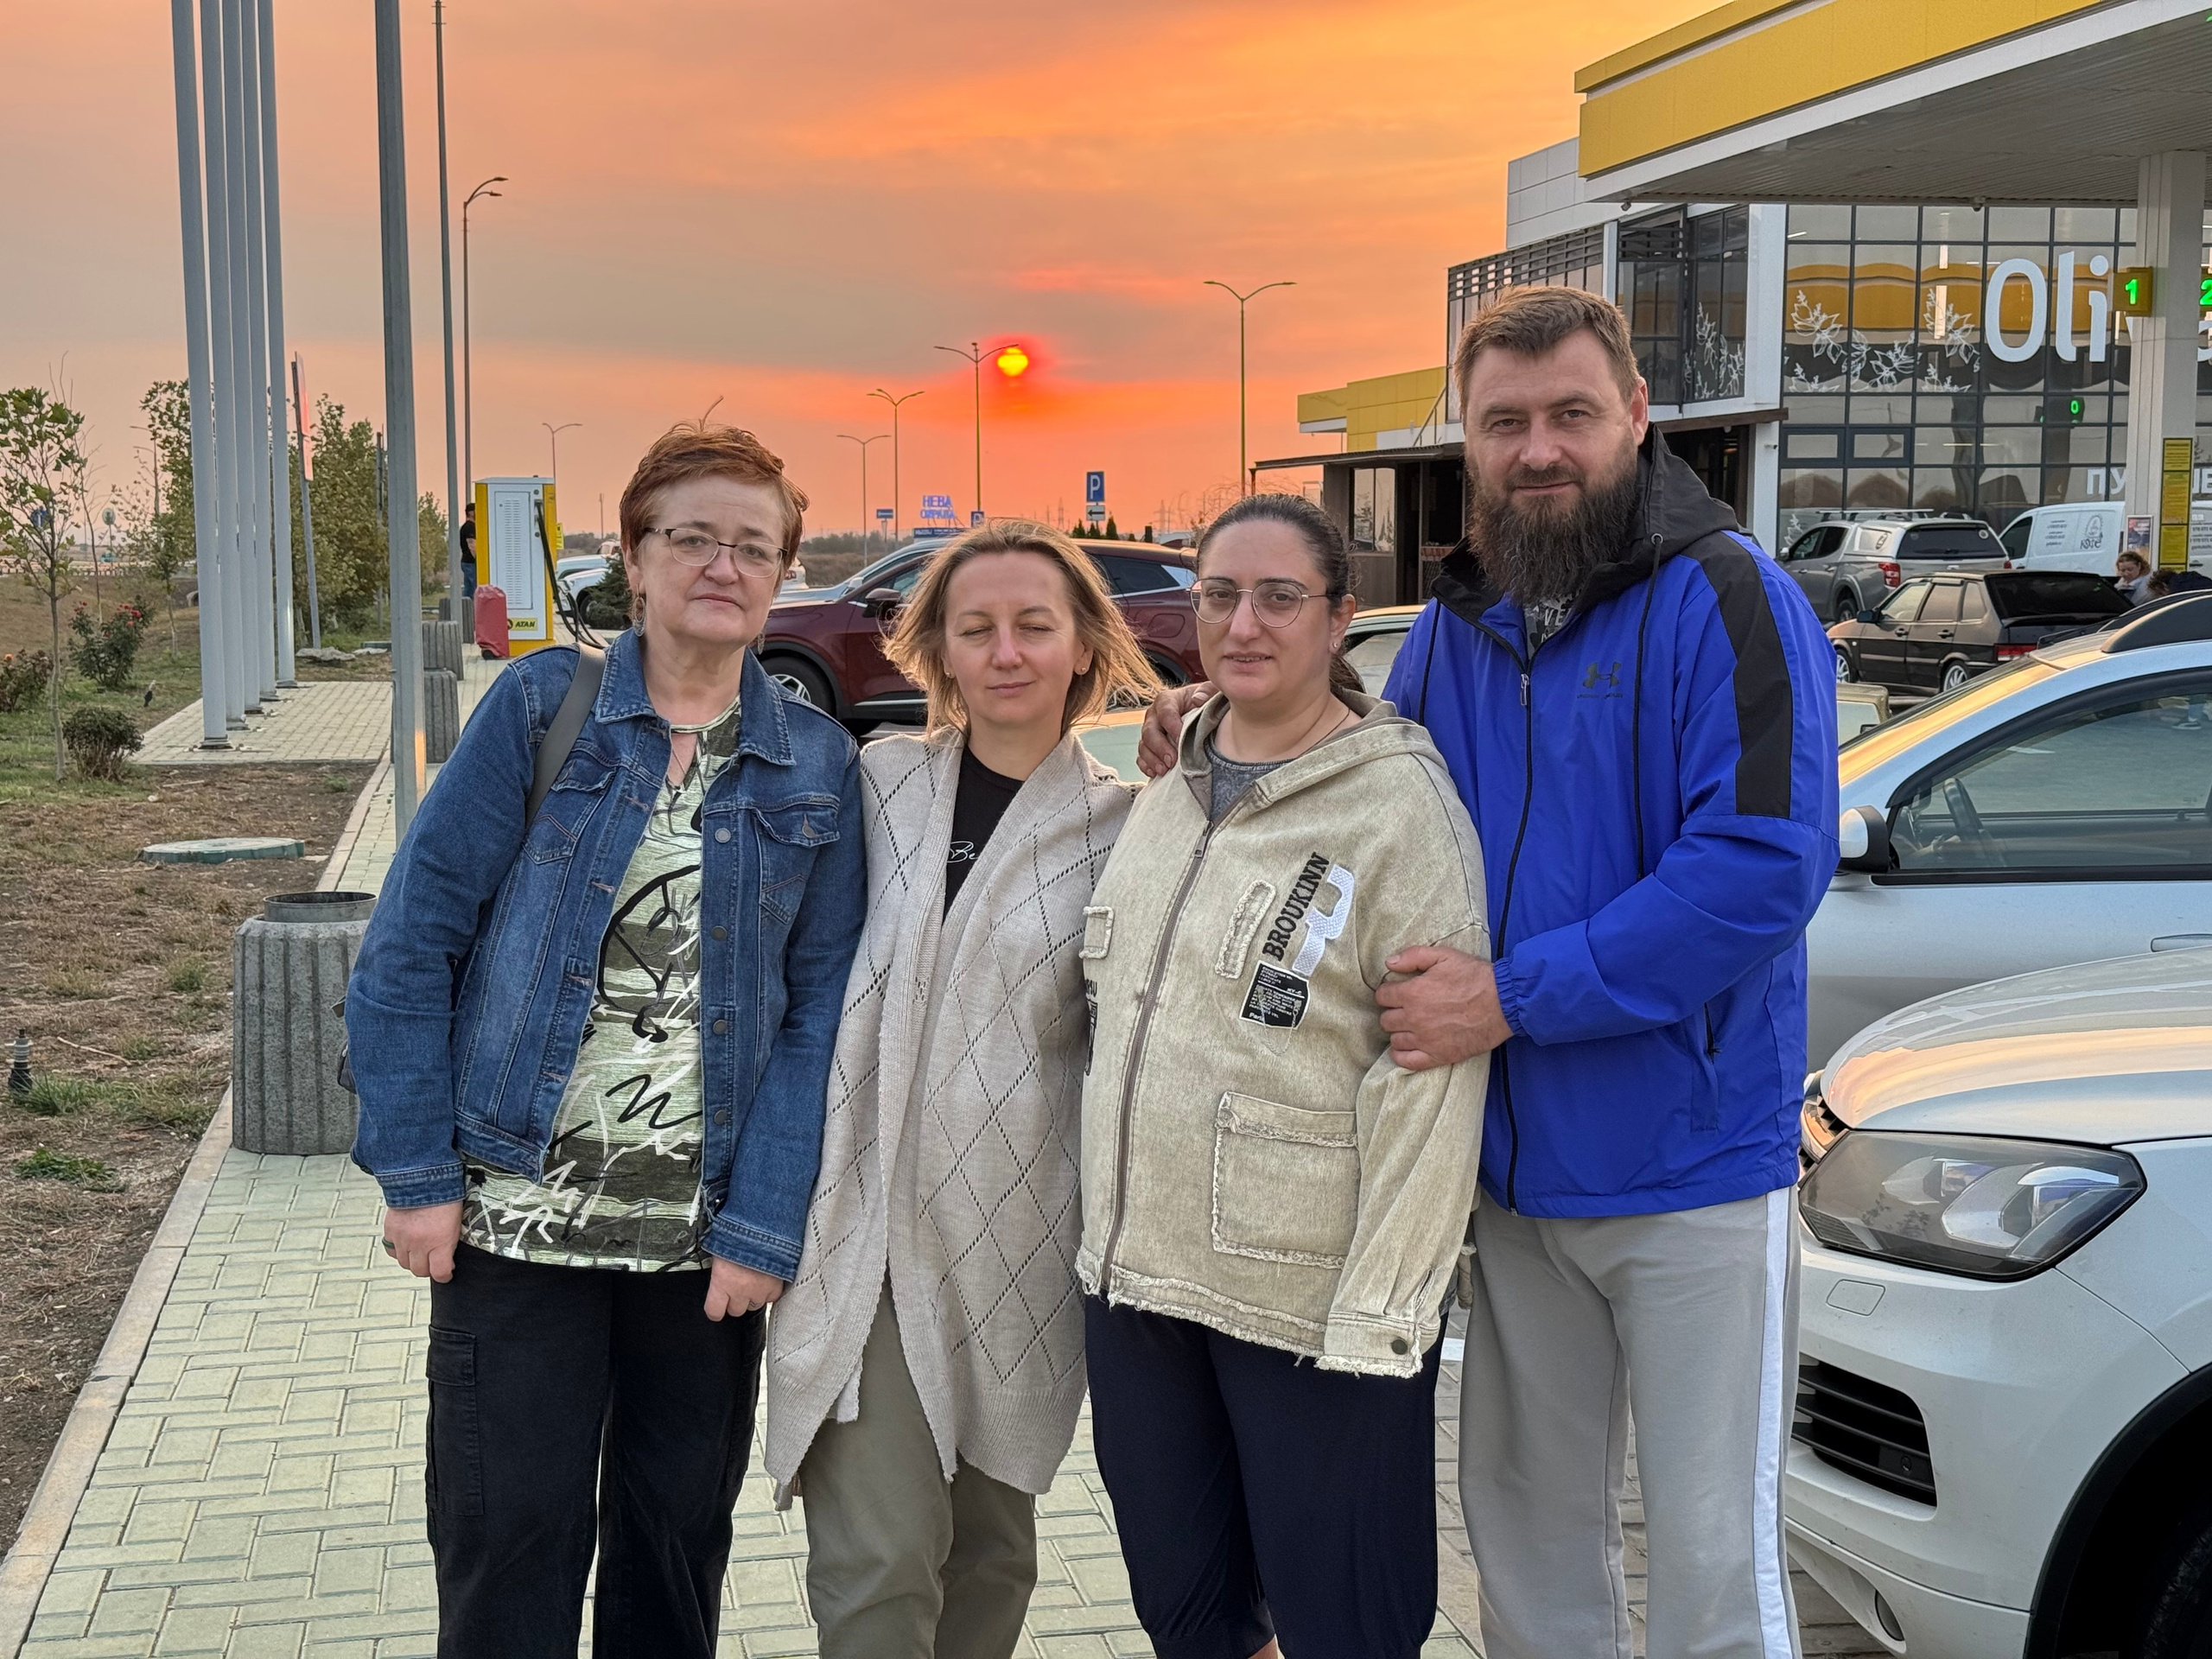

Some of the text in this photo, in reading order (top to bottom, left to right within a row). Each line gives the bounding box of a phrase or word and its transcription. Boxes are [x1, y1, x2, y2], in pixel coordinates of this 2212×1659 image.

[2125, 278, 2139, 305] 1
[1090, 474, 1101, 499] P
[1262, 852, 1330, 962] BROUKINN
